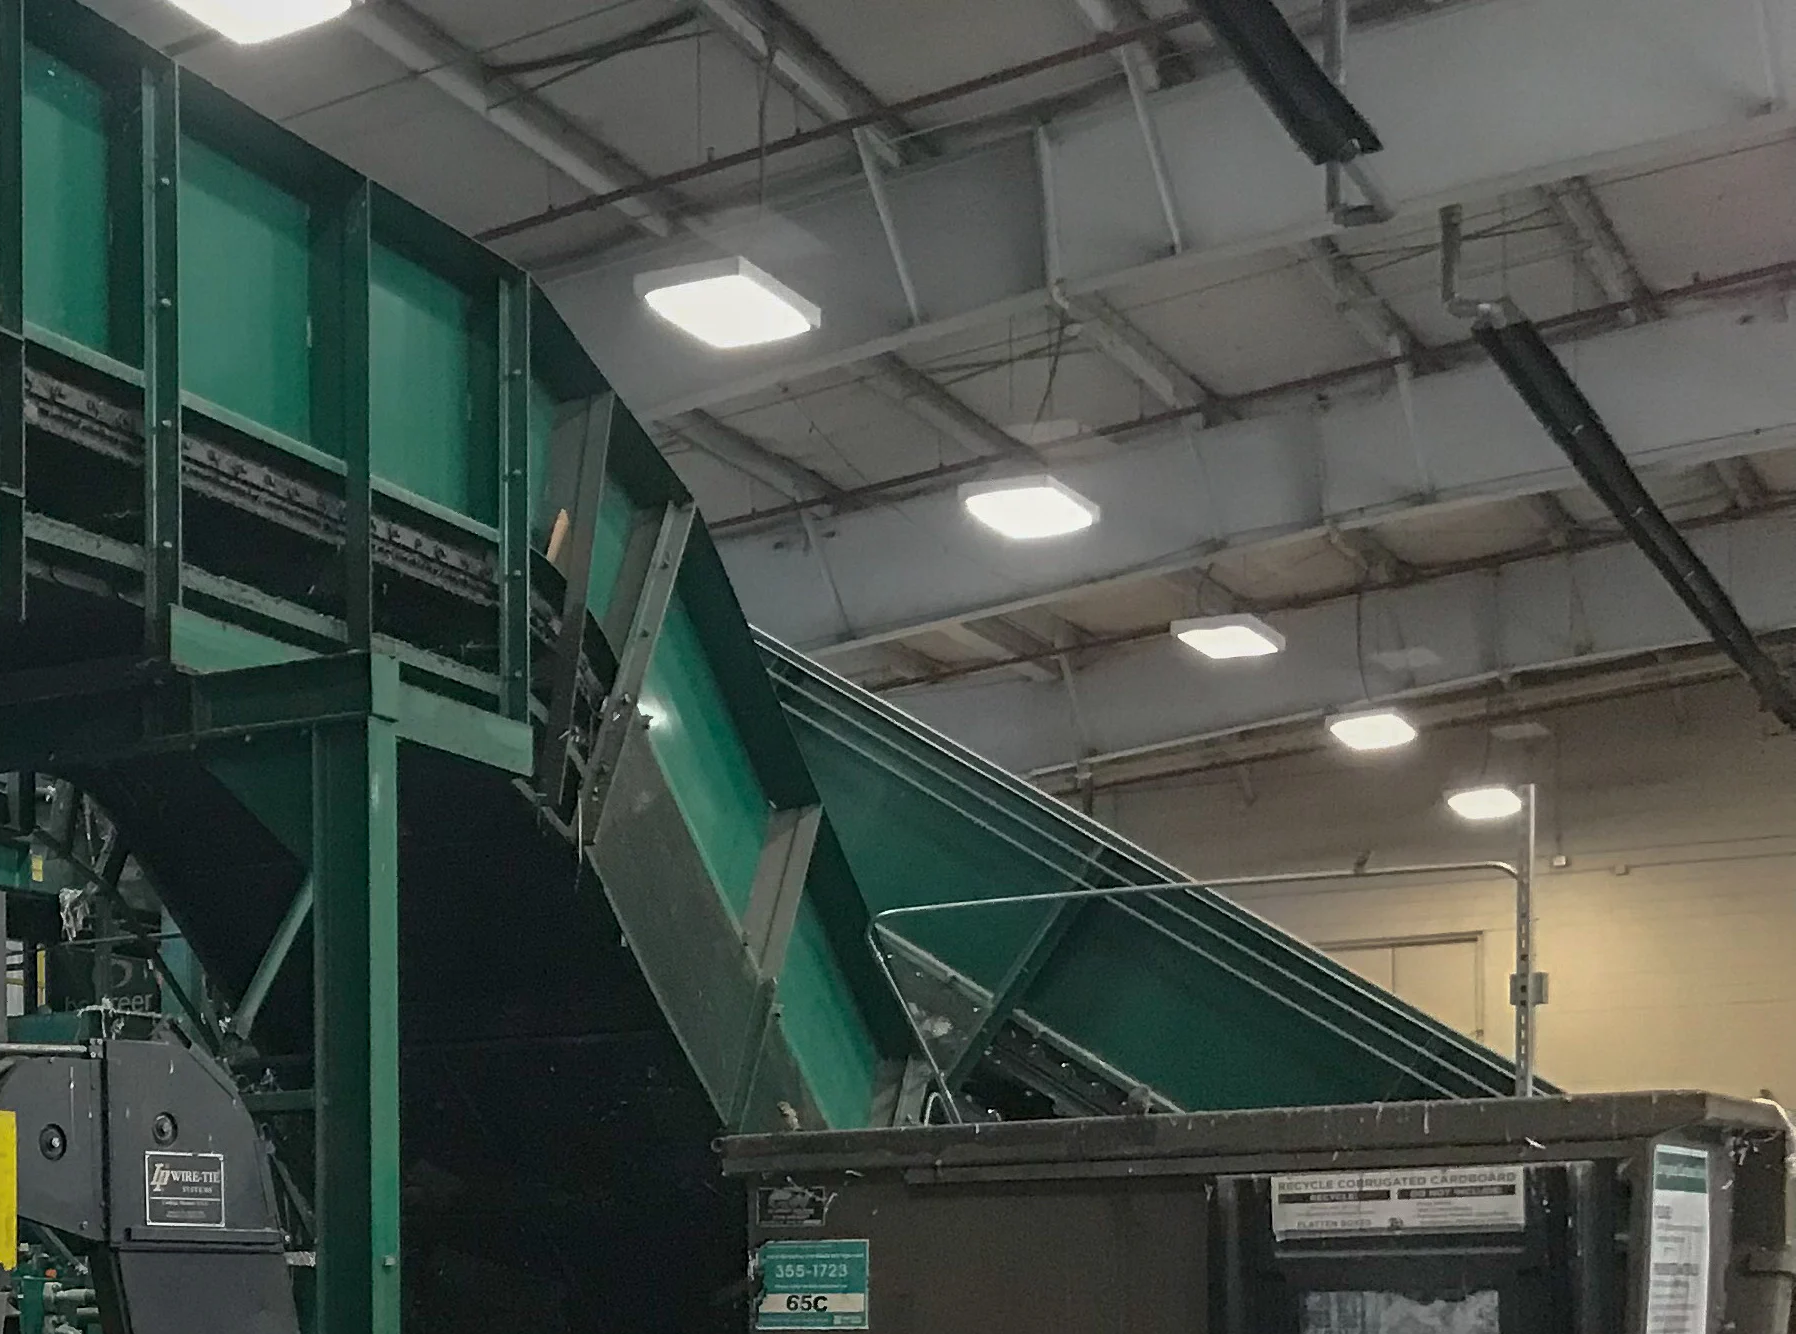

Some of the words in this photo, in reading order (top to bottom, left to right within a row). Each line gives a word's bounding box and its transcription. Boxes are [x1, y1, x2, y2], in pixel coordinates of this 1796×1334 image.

[171, 1169, 220, 1184] WIRE-TIE
[1278, 1180, 1334, 1192] RECYCLE
[1337, 1176, 1427, 1189] CORRUGATED
[1430, 1172, 1517, 1185] CARDBOARD
[775, 1263, 848, 1279] 355-1723
[786, 1294, 828, 1312] 65C
